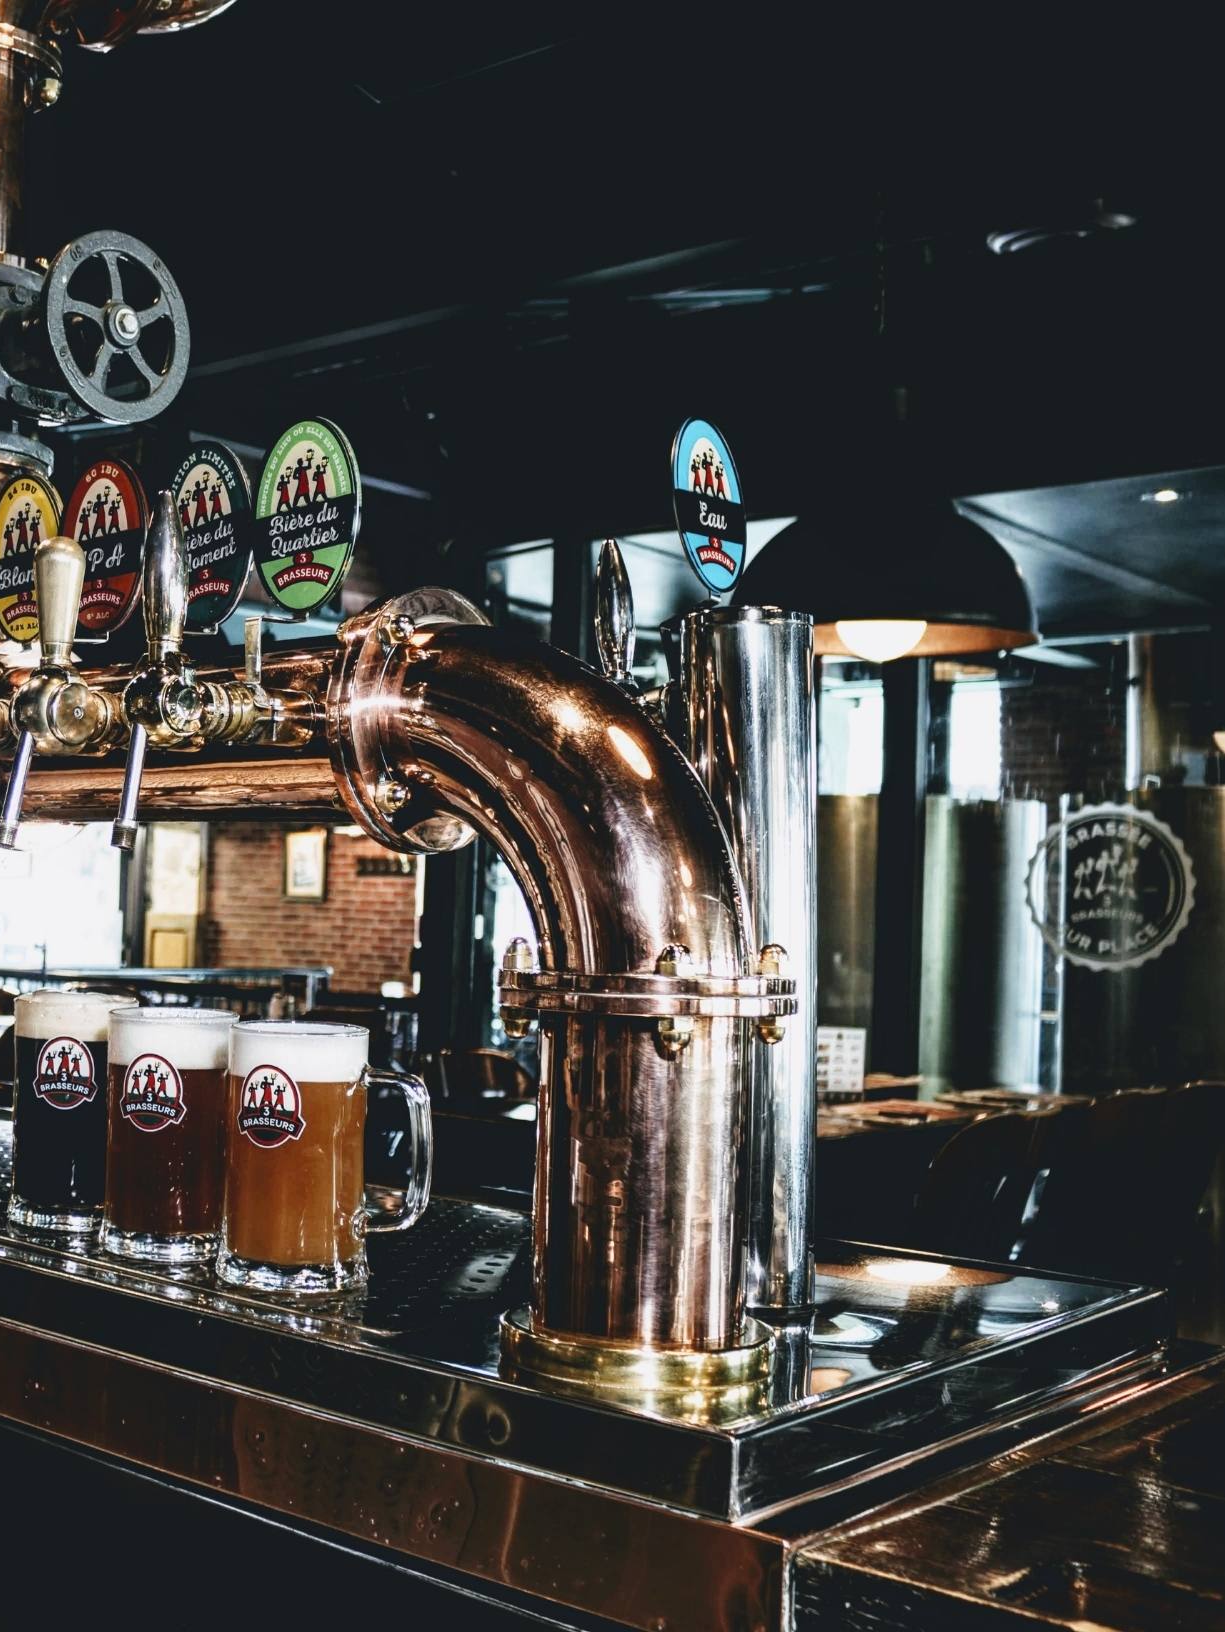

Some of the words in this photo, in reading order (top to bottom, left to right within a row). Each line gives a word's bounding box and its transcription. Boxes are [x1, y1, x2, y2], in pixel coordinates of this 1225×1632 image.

[101, 464, 119, 478] IBU
[172, 452, 197, 496] ITION
[201, 449, 236, 491] LIMITÉE
[21, 482, 38, 495] IBU
[269, 513, 315, 536] Bière
[316, 502, 339, 524] du
[699, 499, 728, 531] Eau
[186, 532, 213, 551] ière
[214, 520, 234, 542] du
[271, 527, 339, 557] Quartier
[712, 538, 718, 547] 3
[300, 553, 307, 564] 3
[700, 550, 734, 571] BRASSEURS
[202, 569, 209, 579] 3
[277, 568, 329, 587] BRASSEURS
[96, 579, 103, 588] 3
[22, 592, 28, 600] 3
[187, 583, 230, 601] RASSEURS
[6, 603, 39, 620] BRASSEU
[1066, 928, 1092, 951] UR
[60, 1072, 68, 1082] 3
[40, 1082, 90, 1095] BRASSEURS
[146, 1092, 153, 1102] 3
[126, 1102, 176, 1117] BRASSEURS
[263, 1106, 270, 1116] 3
[243, 1117, 295, 1132] BRASSEURS
